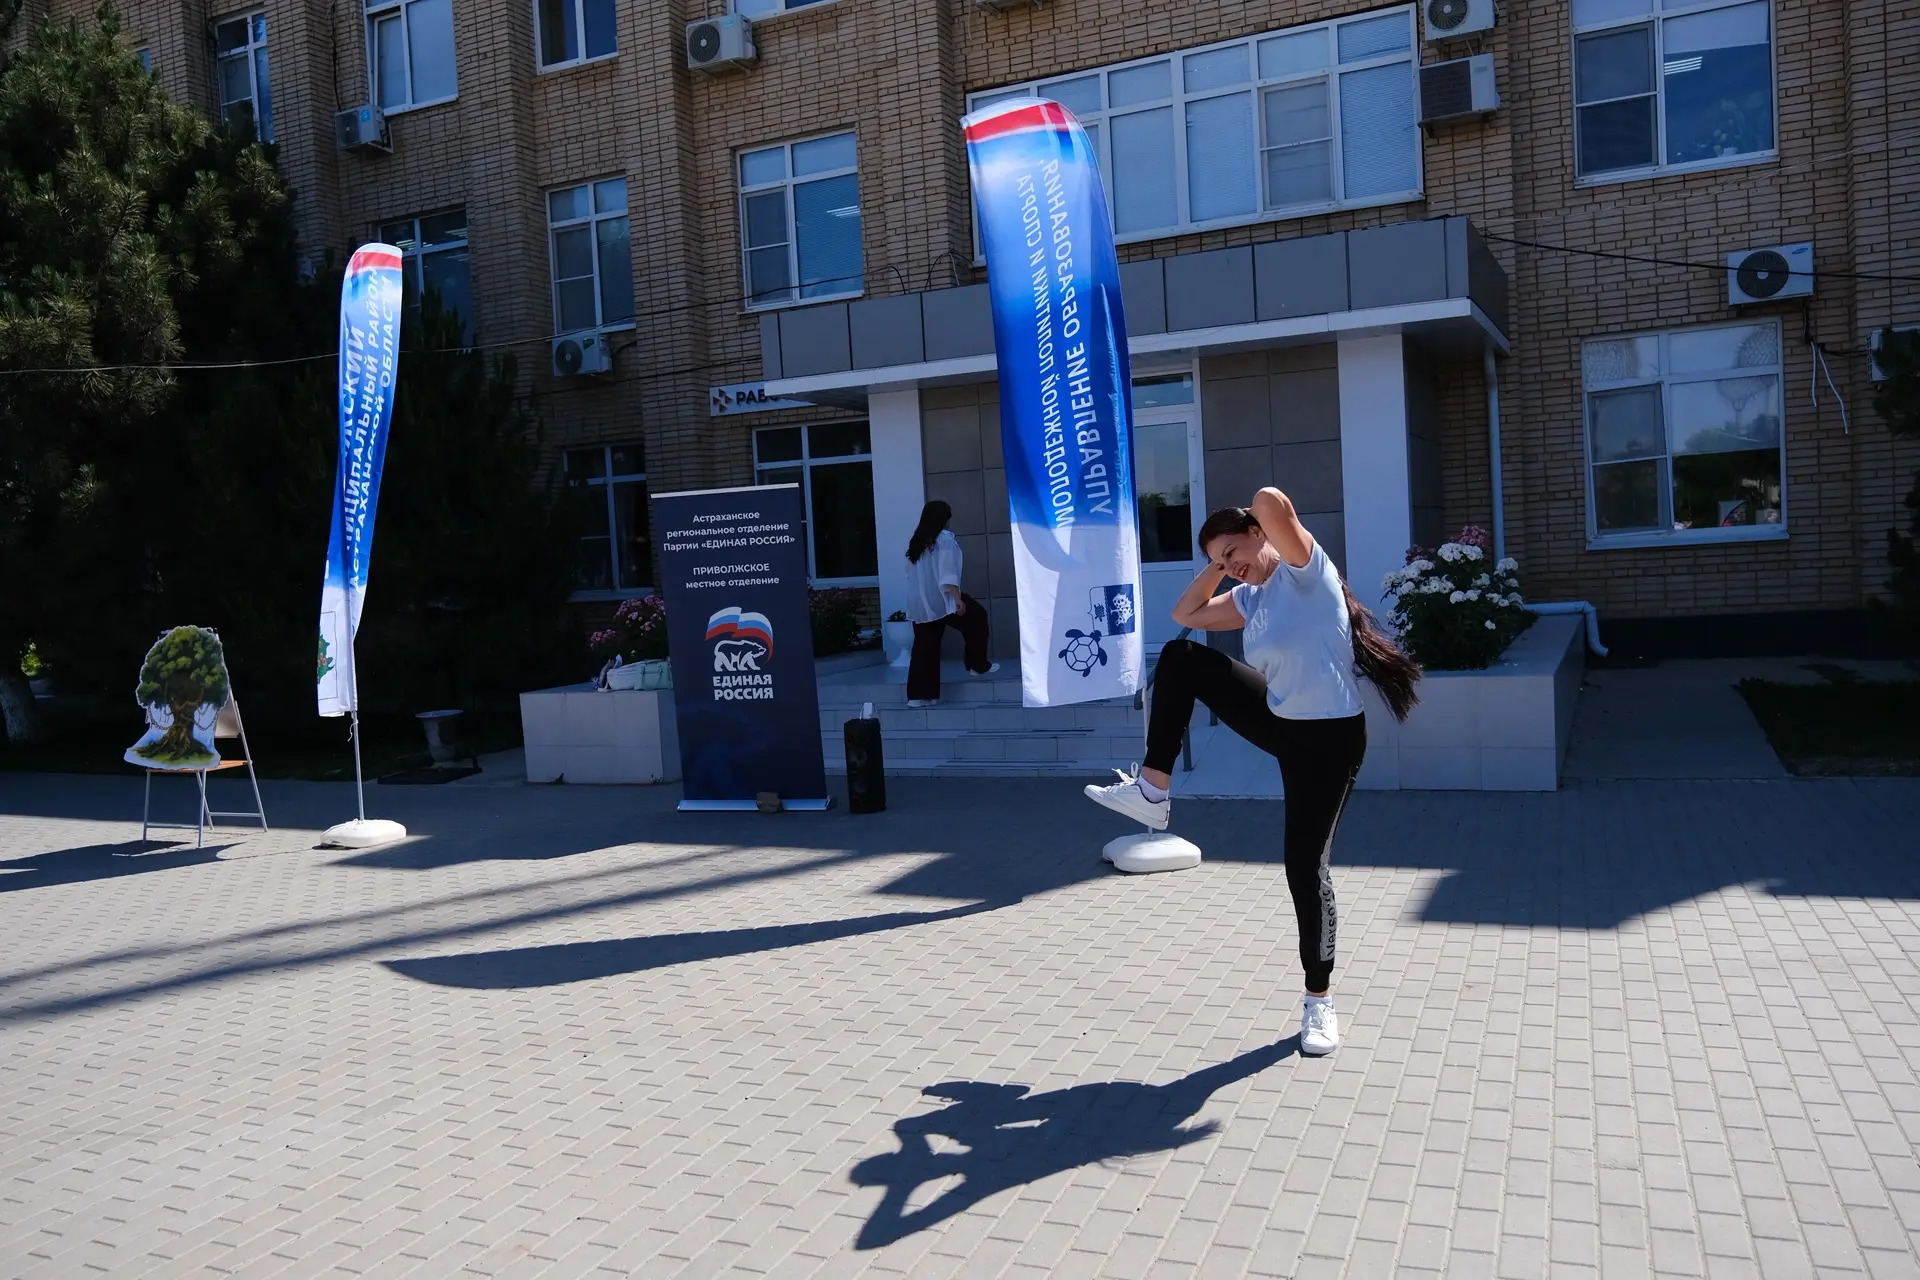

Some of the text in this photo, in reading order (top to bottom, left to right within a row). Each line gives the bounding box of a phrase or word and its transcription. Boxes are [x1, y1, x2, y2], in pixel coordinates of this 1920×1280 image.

[366, 267, 379, 349] РАЙОН
[380, 275, 393, 388] ОБЛАСТИ
[692, 511, 761, 524] Астраханское
[666, 522, 790, 540] региональное отделение
[663, 534, 796, 553] Партии «ЕДИНАЯ РОССИЯ»
[692, 562, 770, 576] ПРИВОЛЖСКОЕ
[685, 576, 780, 590] местное отделение
[712, 674, 773, 688] ЕДИНАЯ
[713, 687, 774, 701] РОССИЯ
